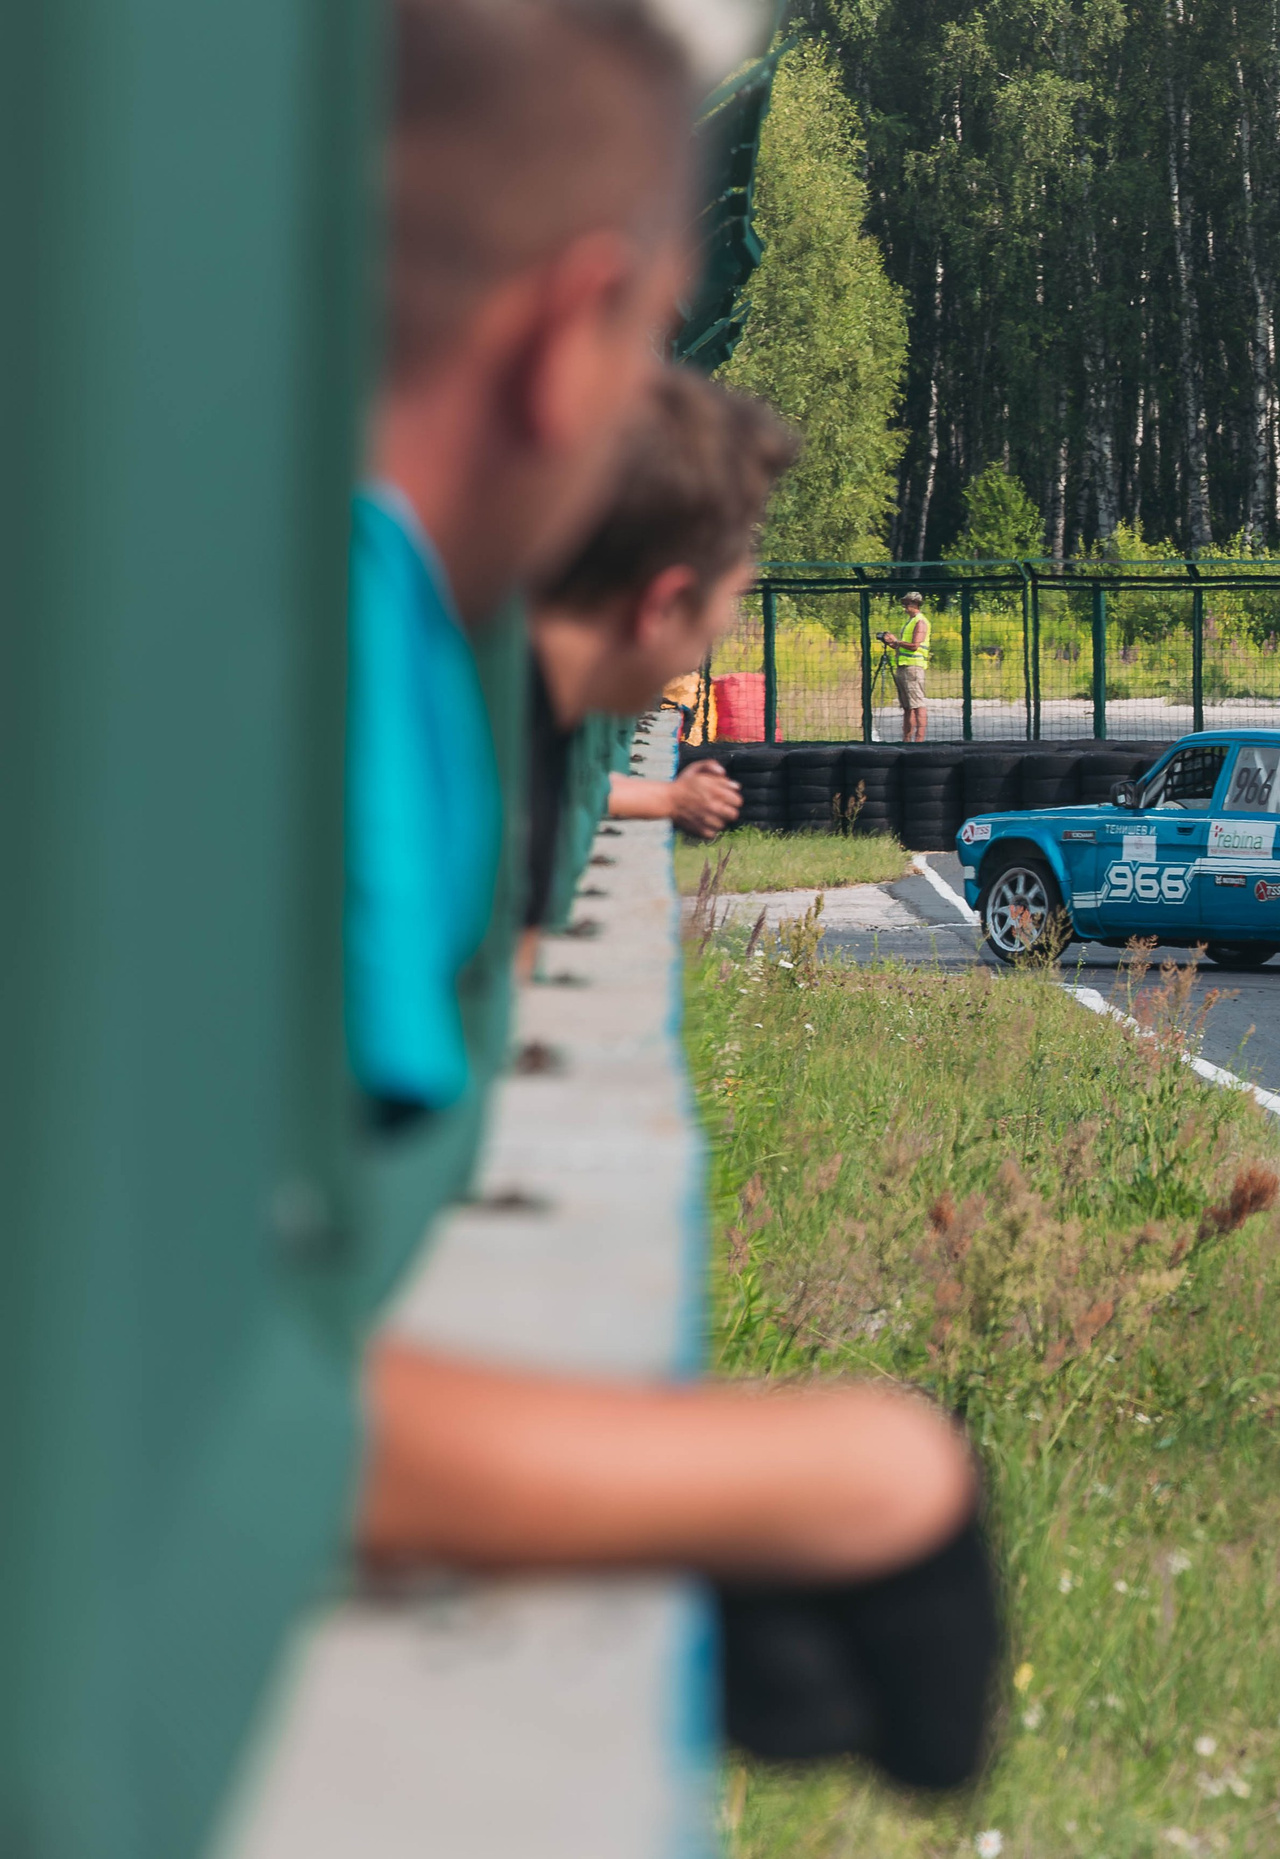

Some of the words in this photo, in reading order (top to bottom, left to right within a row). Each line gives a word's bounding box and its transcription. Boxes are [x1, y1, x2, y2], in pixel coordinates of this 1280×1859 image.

[1233, 767, 1276, 805] 966
[1217, 830, 1263, 849] rebina
[1108, 866, 1187, 899] 966
